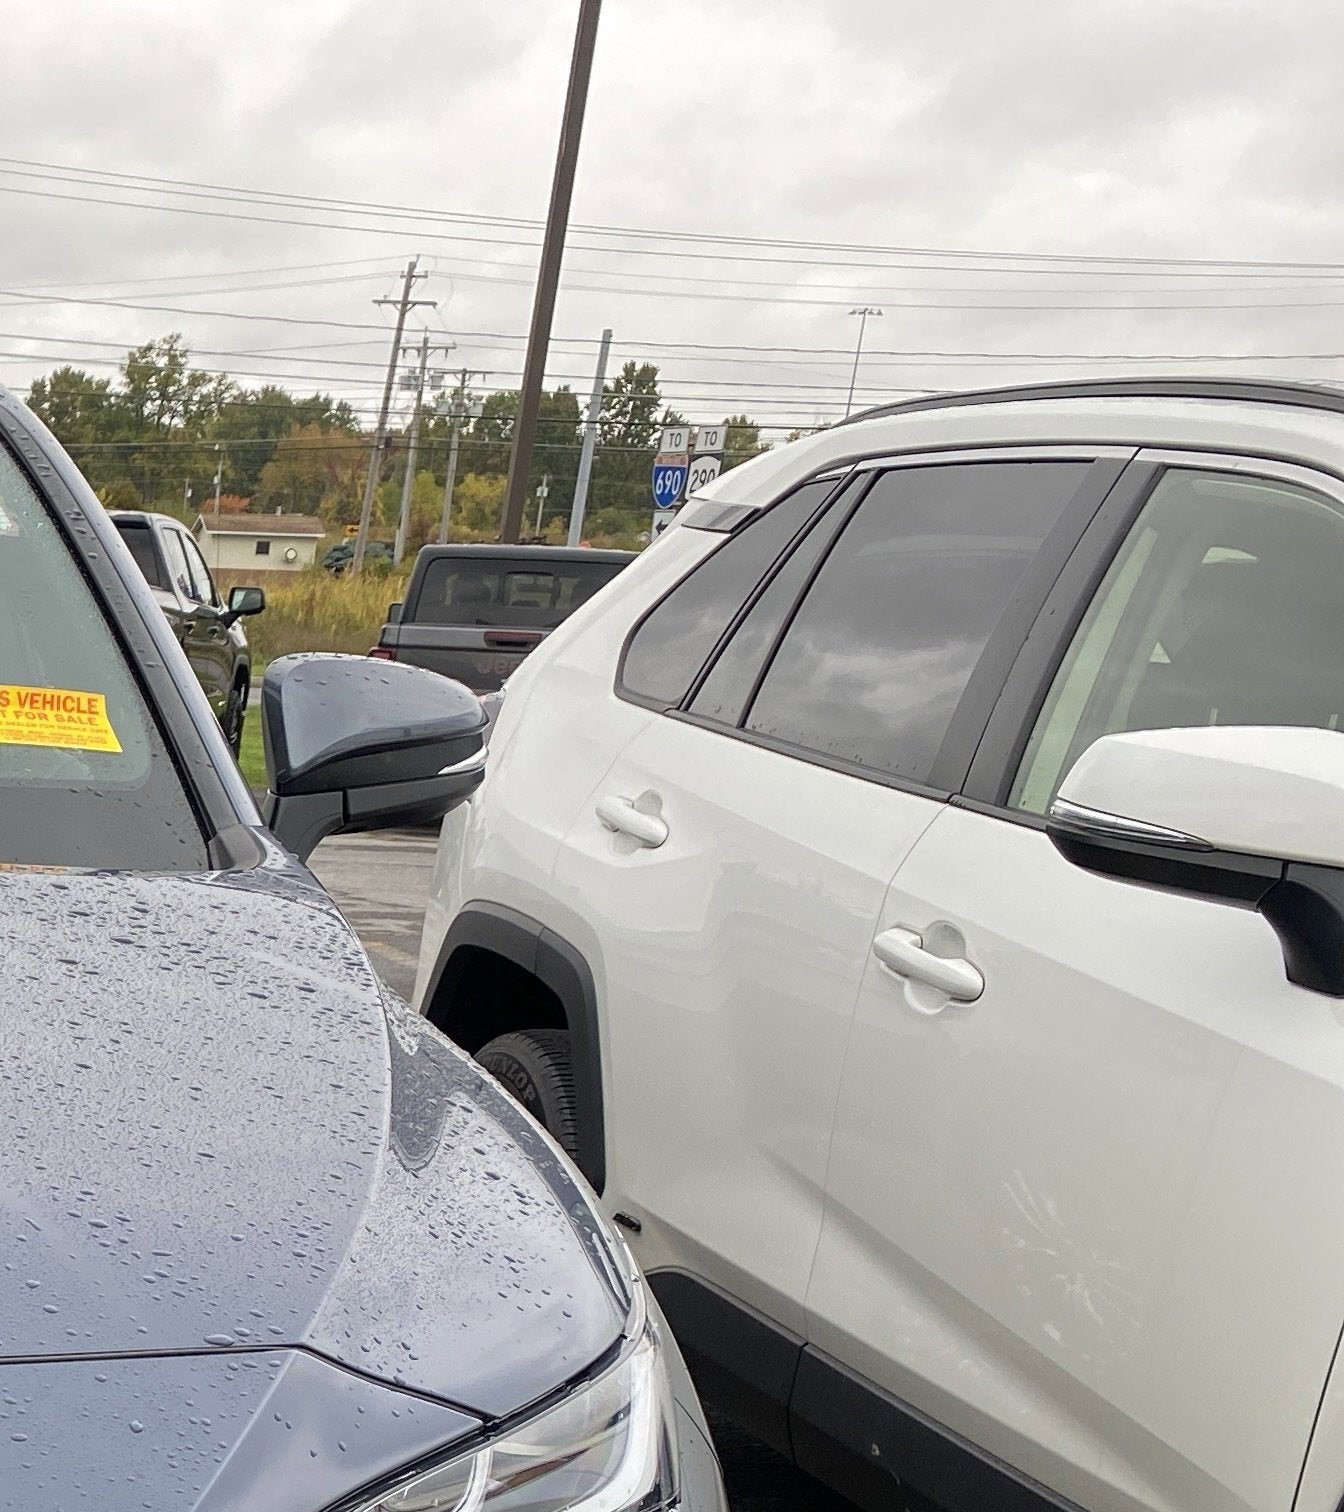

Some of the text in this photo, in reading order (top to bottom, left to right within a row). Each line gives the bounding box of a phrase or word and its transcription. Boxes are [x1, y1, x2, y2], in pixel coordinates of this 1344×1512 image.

[669, 432, 682, 448] TO
[704, 430, 718, 447] TO
[655, 470, 682, 495] 690
[16, 690, 100, 715] VEHICLE
[13, 710, 49, 722] FOR
[54, 713, 99, 727] SALE
